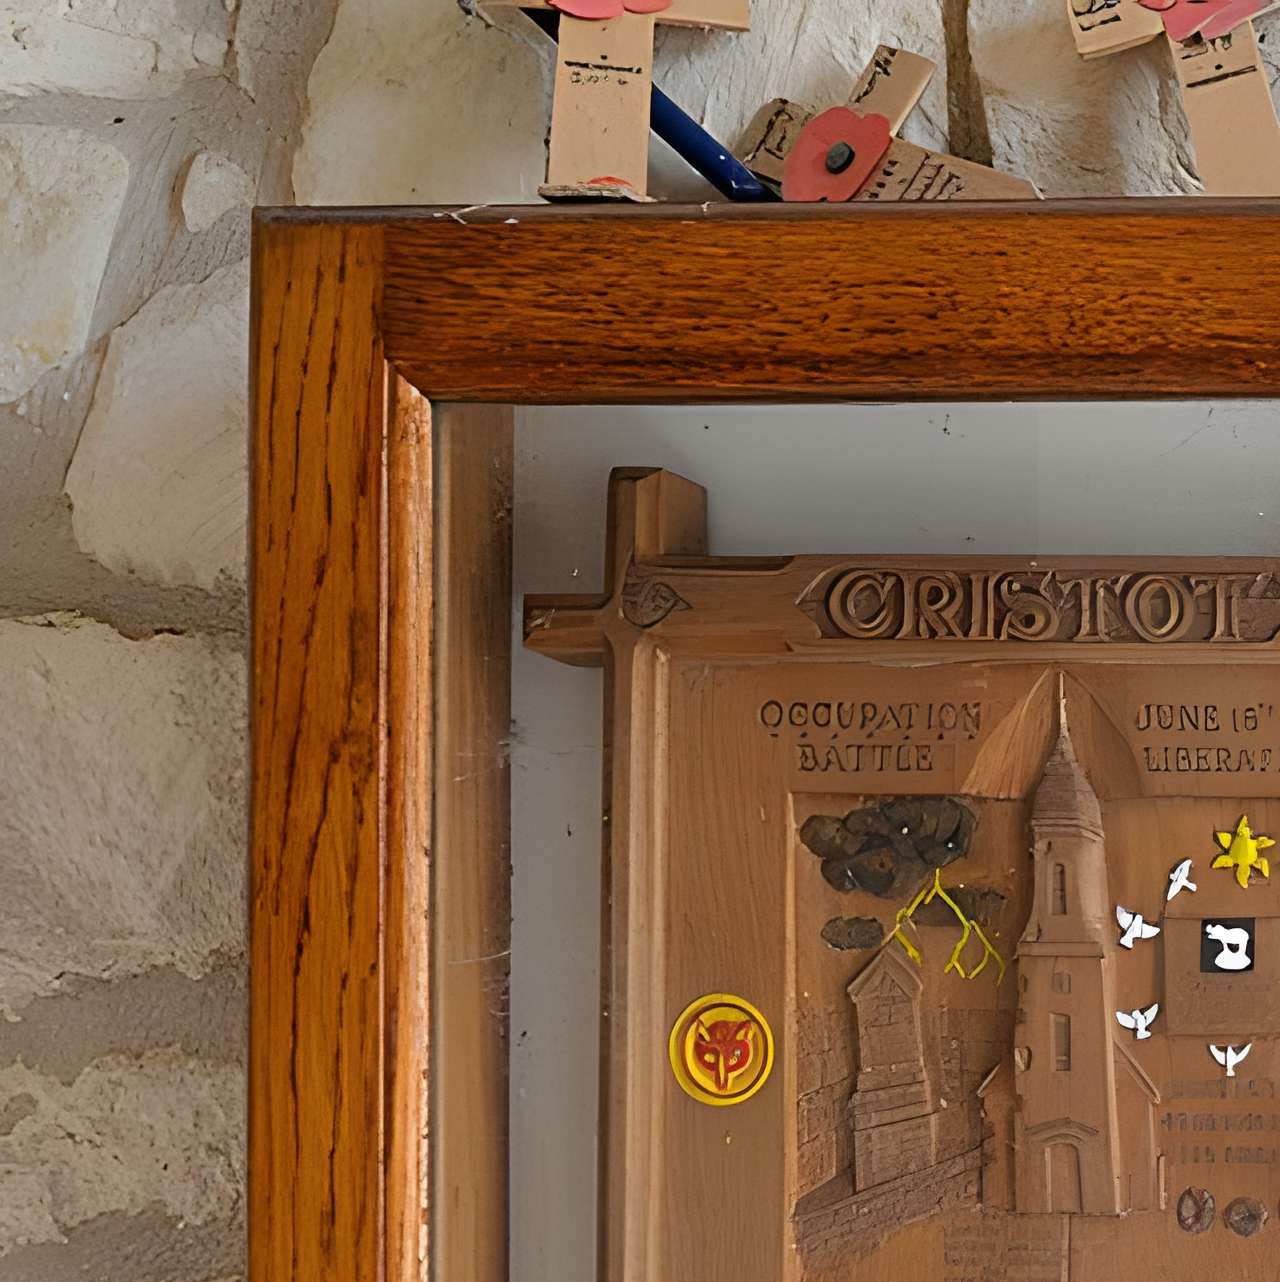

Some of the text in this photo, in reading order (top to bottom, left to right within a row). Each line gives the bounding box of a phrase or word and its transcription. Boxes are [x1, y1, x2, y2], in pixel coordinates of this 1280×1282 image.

[827, 569, 1258, 642] CRISTOT
[759, 699, 982, 735] OCCUPATION
[1136, 703, 1220, 731] JUNE
[797, 744, 934, 772] BATTLE
